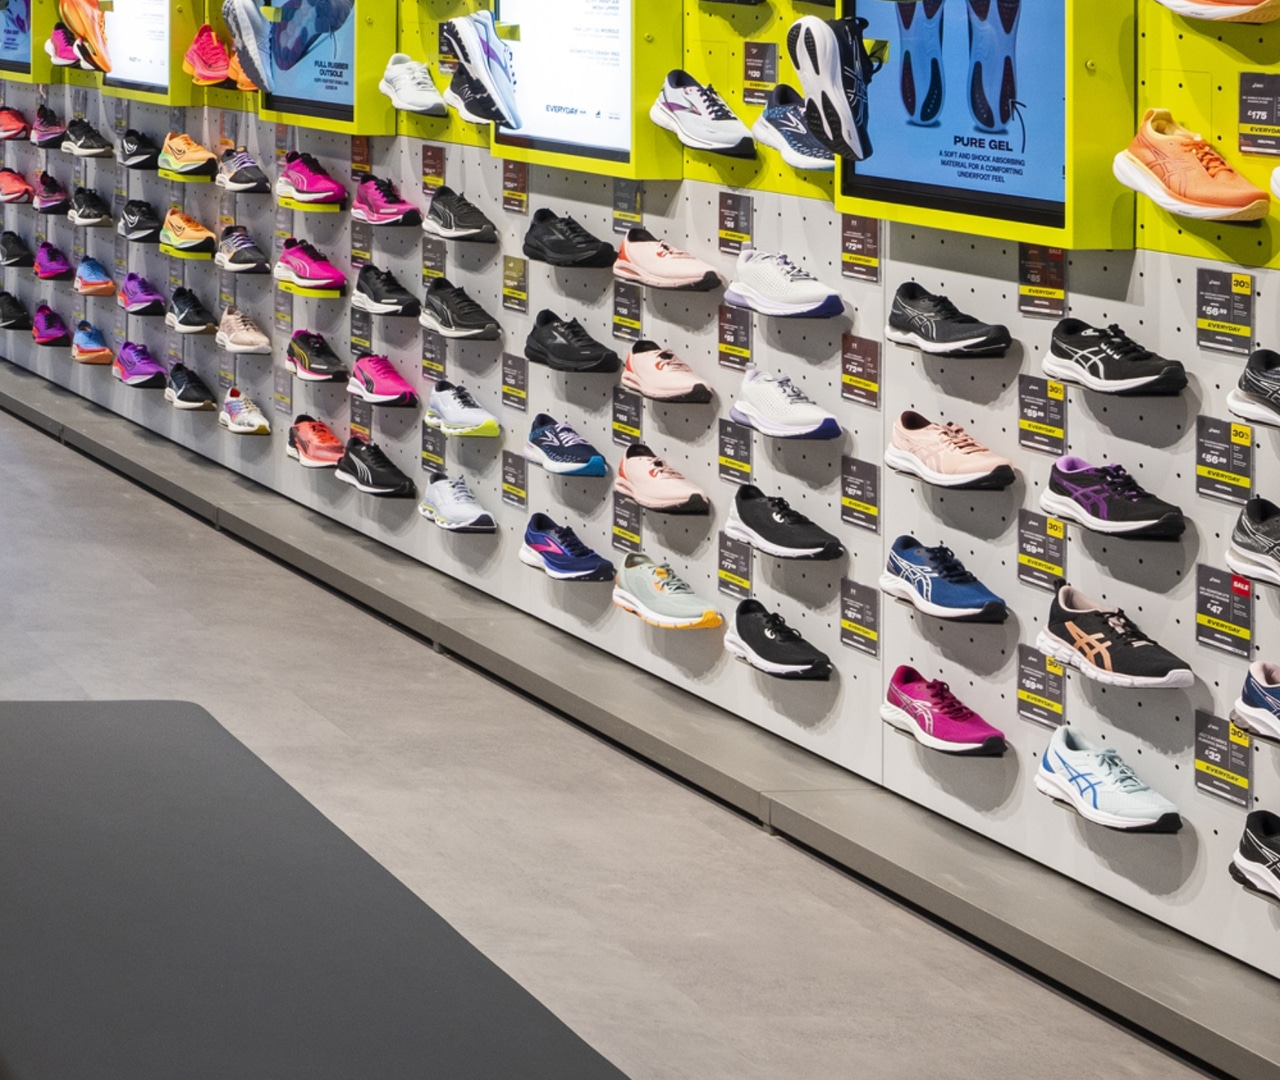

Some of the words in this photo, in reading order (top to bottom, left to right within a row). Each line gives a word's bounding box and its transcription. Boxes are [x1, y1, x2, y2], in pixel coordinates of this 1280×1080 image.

[1247, 110, 1268, 120] £175
[953, 135, 986, 148] PURE
[988, 139, 1013, 152] GEL
[944, 150, 958, 158] SOFT
[958, 151, 971, 160] AND
[971, 153, 992, 162] SHOCK
[992, 156, 1025, 167] ABSORBING
[940, 159, 967, 169] MATERIAL
[968, 162, 979, 170] FOR
[985, 165, 1023, 176] COMFORTING
[957, 170, 991, 181] UNDERFOOT
[1207, 602, 1223, 615] £47
